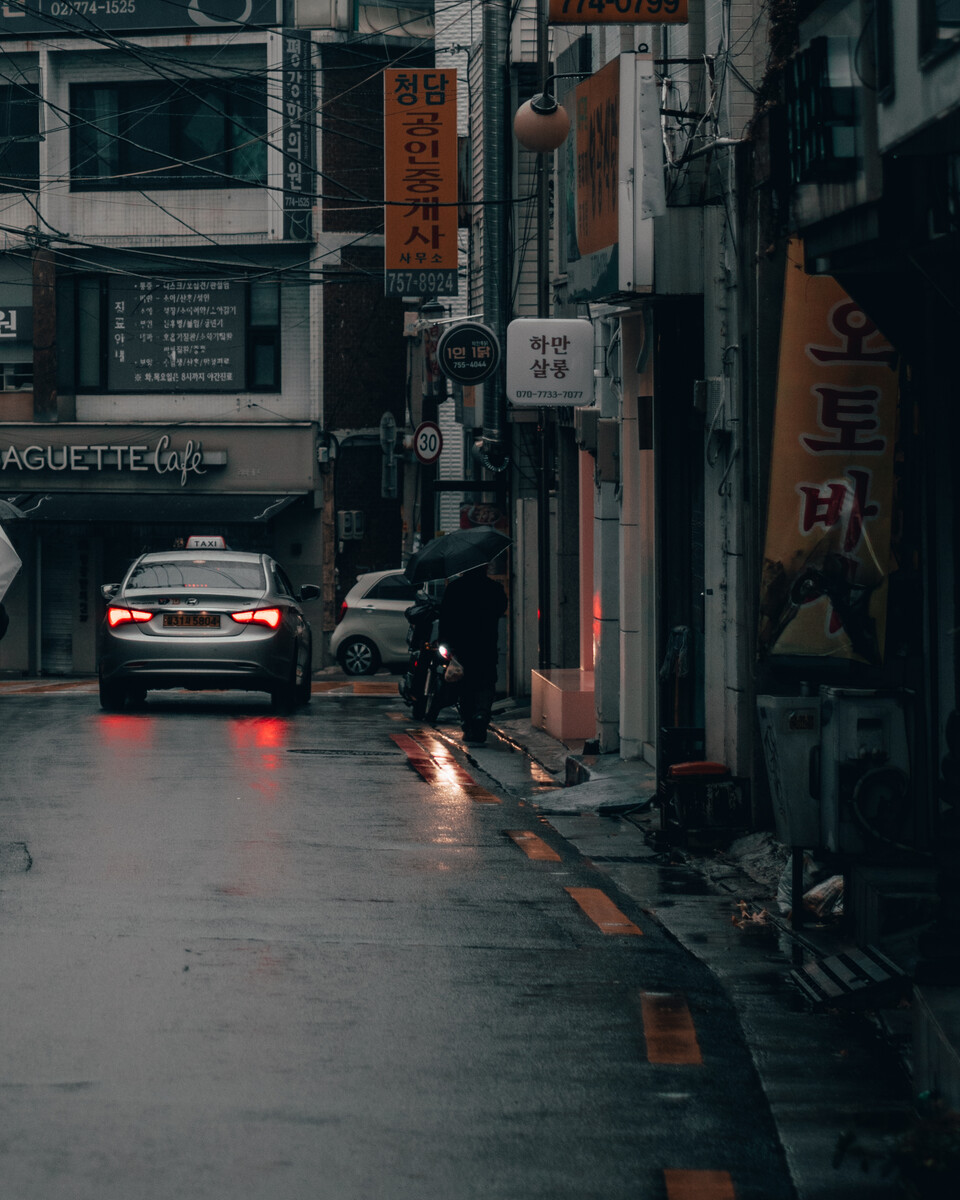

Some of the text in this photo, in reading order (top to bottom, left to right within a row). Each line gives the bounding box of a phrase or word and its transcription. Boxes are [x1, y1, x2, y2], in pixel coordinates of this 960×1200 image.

[51, 0, 136, 16] 02)774-1525
[394, 73, 449, 106] 청담
[286, 38, 302, 191] 평강한의원
[402, 111, 445, 249] 공인중개사
[399, 252, 443, 264] 사무소
[114, 301, 125, 362] 진료안내
[529, 335, 571, 355] 하만
[453, 361, 487, 369] 755-4044
[529, 358, 570, 379] 살롱
[516, 390, 583, 399] 070-7733-7077
[419, 433, 437, 452] 30
[154, 435, 208, 487] Café
[797, 300, 897, 633] 오토바
